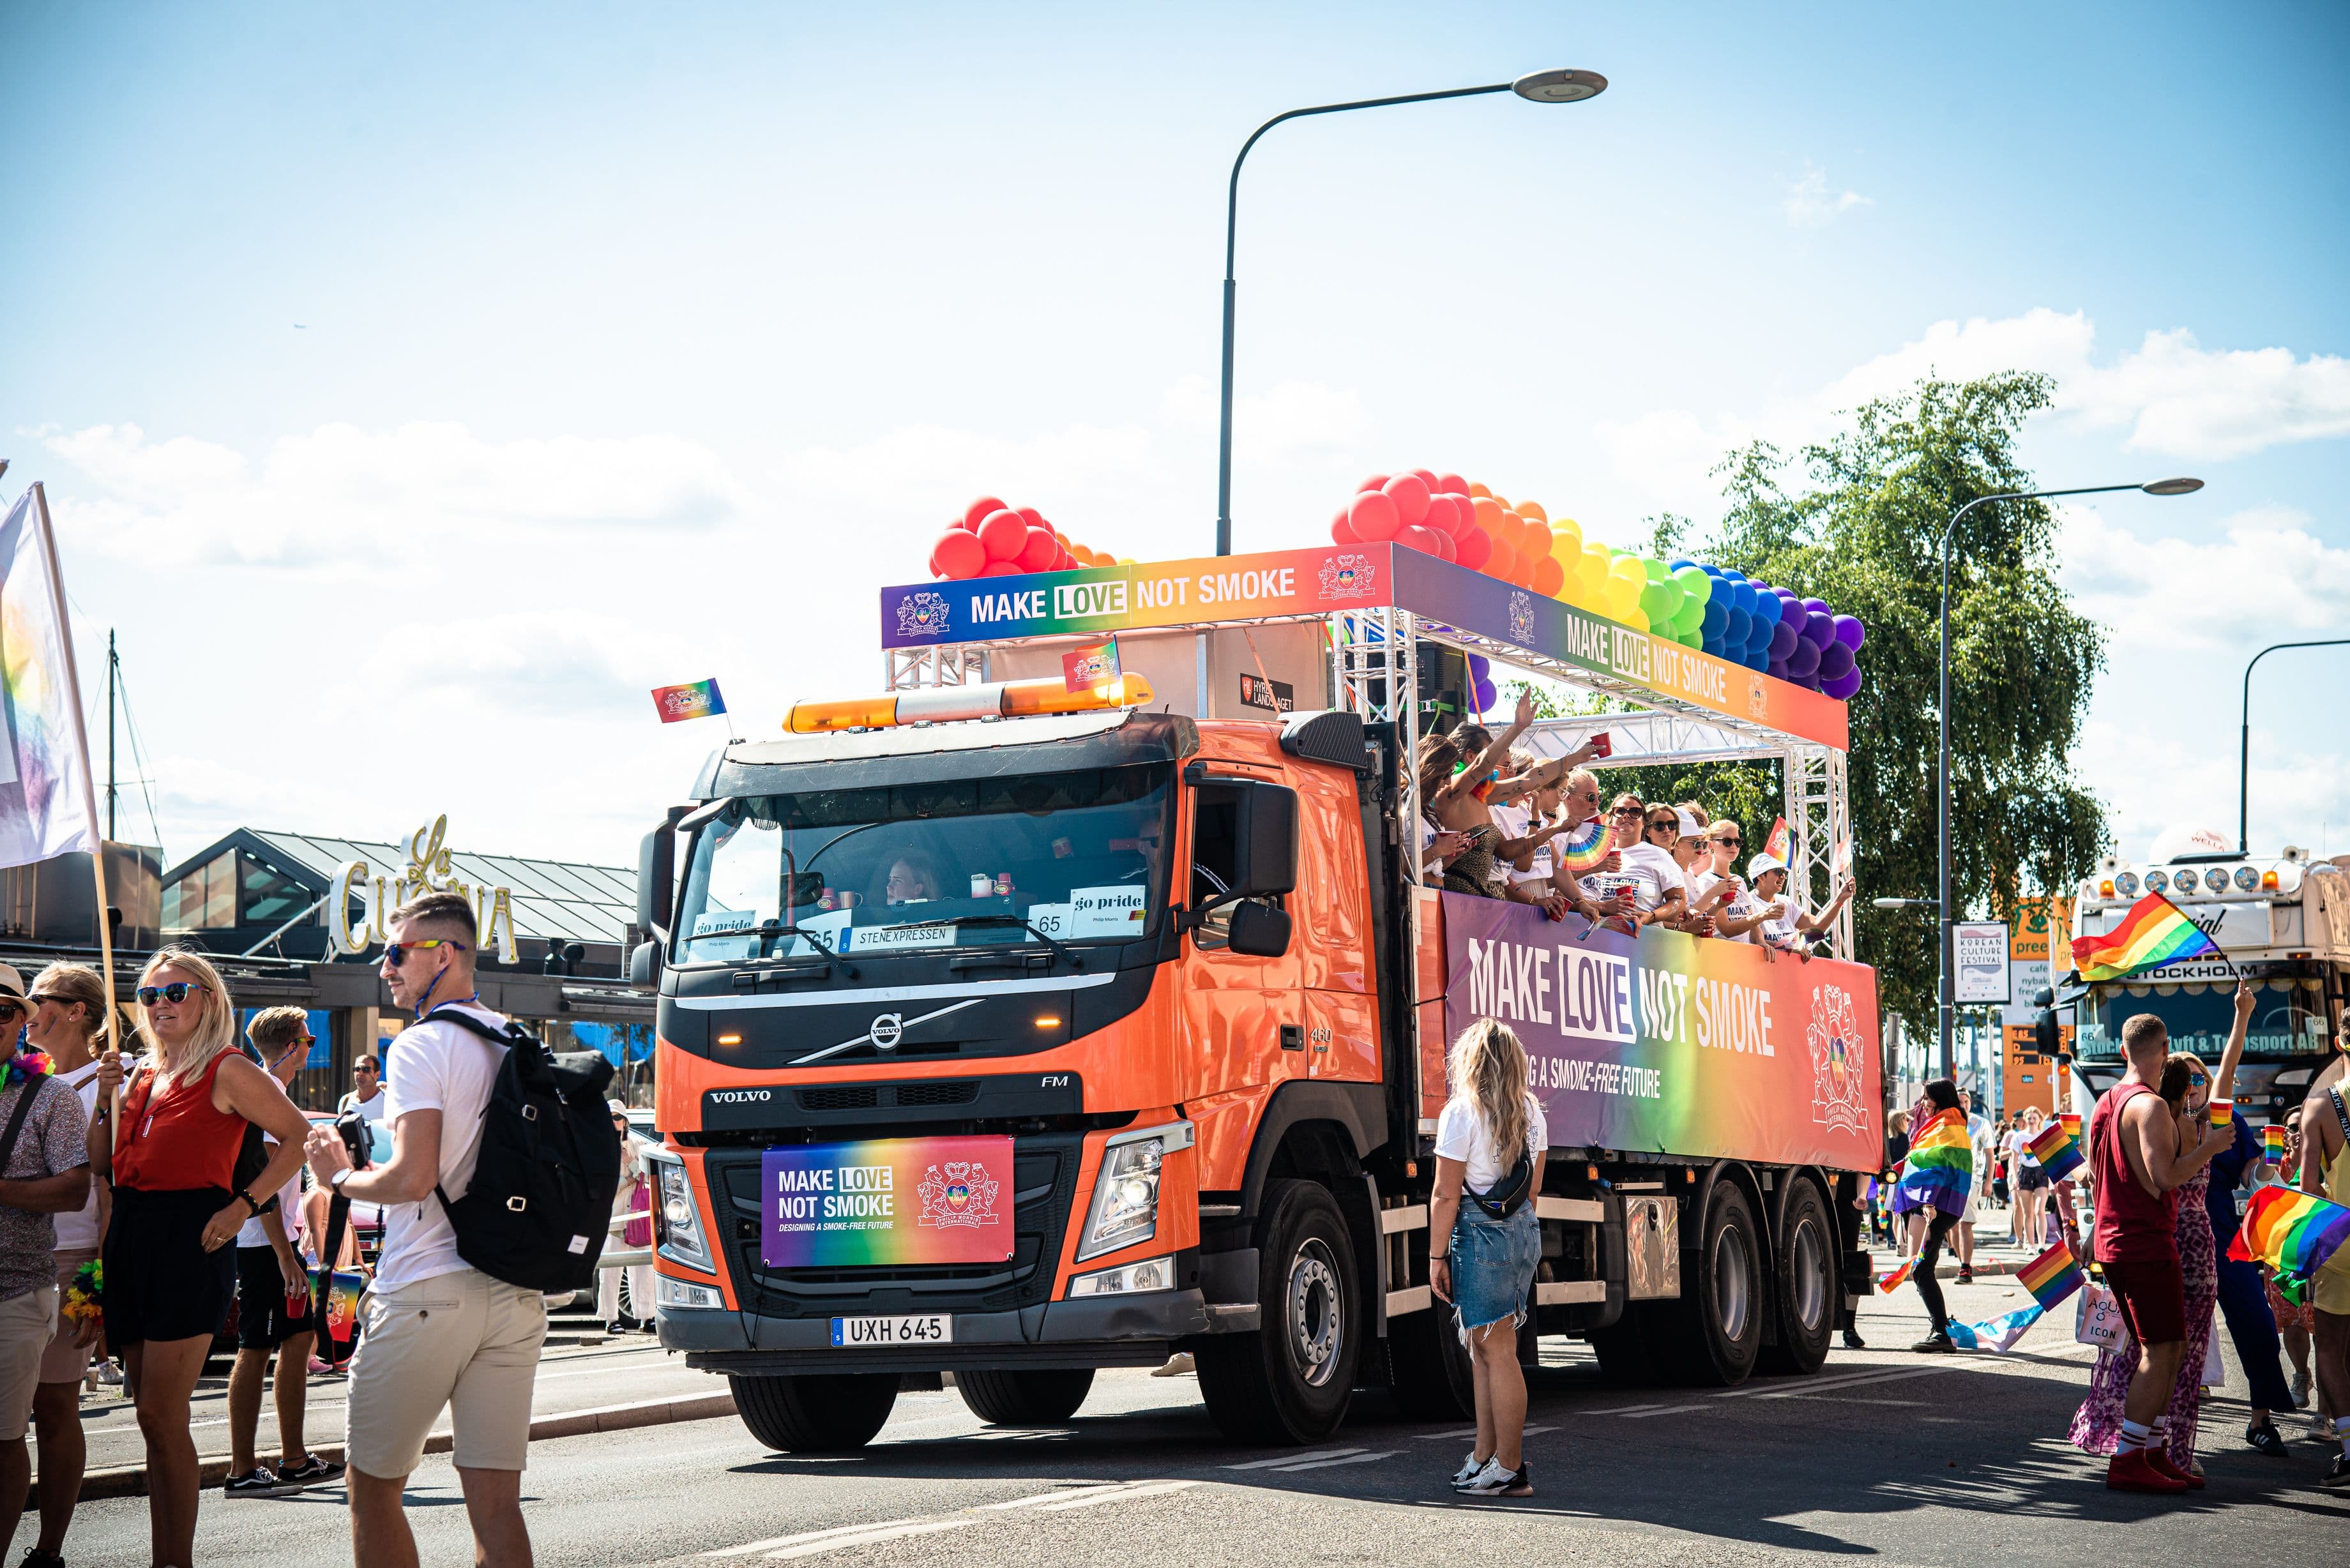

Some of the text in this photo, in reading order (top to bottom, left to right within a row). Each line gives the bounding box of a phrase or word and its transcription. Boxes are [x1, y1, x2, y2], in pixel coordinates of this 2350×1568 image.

[971, 568, 1296, 624] MAKE LOVE NOT SMOKE
[1566, 613, 1727, 704] MAKE LOVE NOT SMOKE
[1254, 691, 1292, 711] LANDSAGET
[2191, 836, 2225, 853] WELLA
[1074, 894, 1142, 912] go pride
[1727, 906, 1747, 916] MAKE
[695, 919, 752, 935] go pride
[1039, 916, 1061, 933] 65
[809, 930, 833, 951] 65
[860, 928, 946, 944] STENEXPRESSEN
[1960, 939, 2002, 947] KOREAN
[1960, 947, 2002, 956] CULTURE
[2029, 964, 2048, 973] café
[1468, 937, 1775, 1057] MAKE LOVE NOT SMOKE
[2313, 1017, 2324, 1026] 66
[1310, 1028, 1333, 1042] 460
[2081, 1032, 2095, 1042] 66
[2198, 1037, 2210, 1052] &
[2212, 1034, 2294, 1052] Trnsport
[2297, 1033, 2319, 1050] AB
[1042, 1076, 1068, 1087] FM
[1538, 1057, 1549, 1089] A
[1550, 1057, 1620, 1094] SMOKE-FREE
[1621, 1065, 1660, 1099] FUTURE
[709, 1090, 771, 1103] VOLVO
[1827, 1104, 1855, 1122] PHILIP MORRIS
[1828, 1113, 1854, 1131] INTERNATIONAL
[778, 1168, 890, 1192] MAKE LOVE
[778, 1194, 894, 1219] NOT SMOKE
[778, 1220, 894, 1232] DESIGNING A SMOKE-FREE FUTURE
[939, 1215, 957, 1223] PHILIP
[851, 1319, 891, 1342] UXH
[899, 1318, 942, 1341] 645
